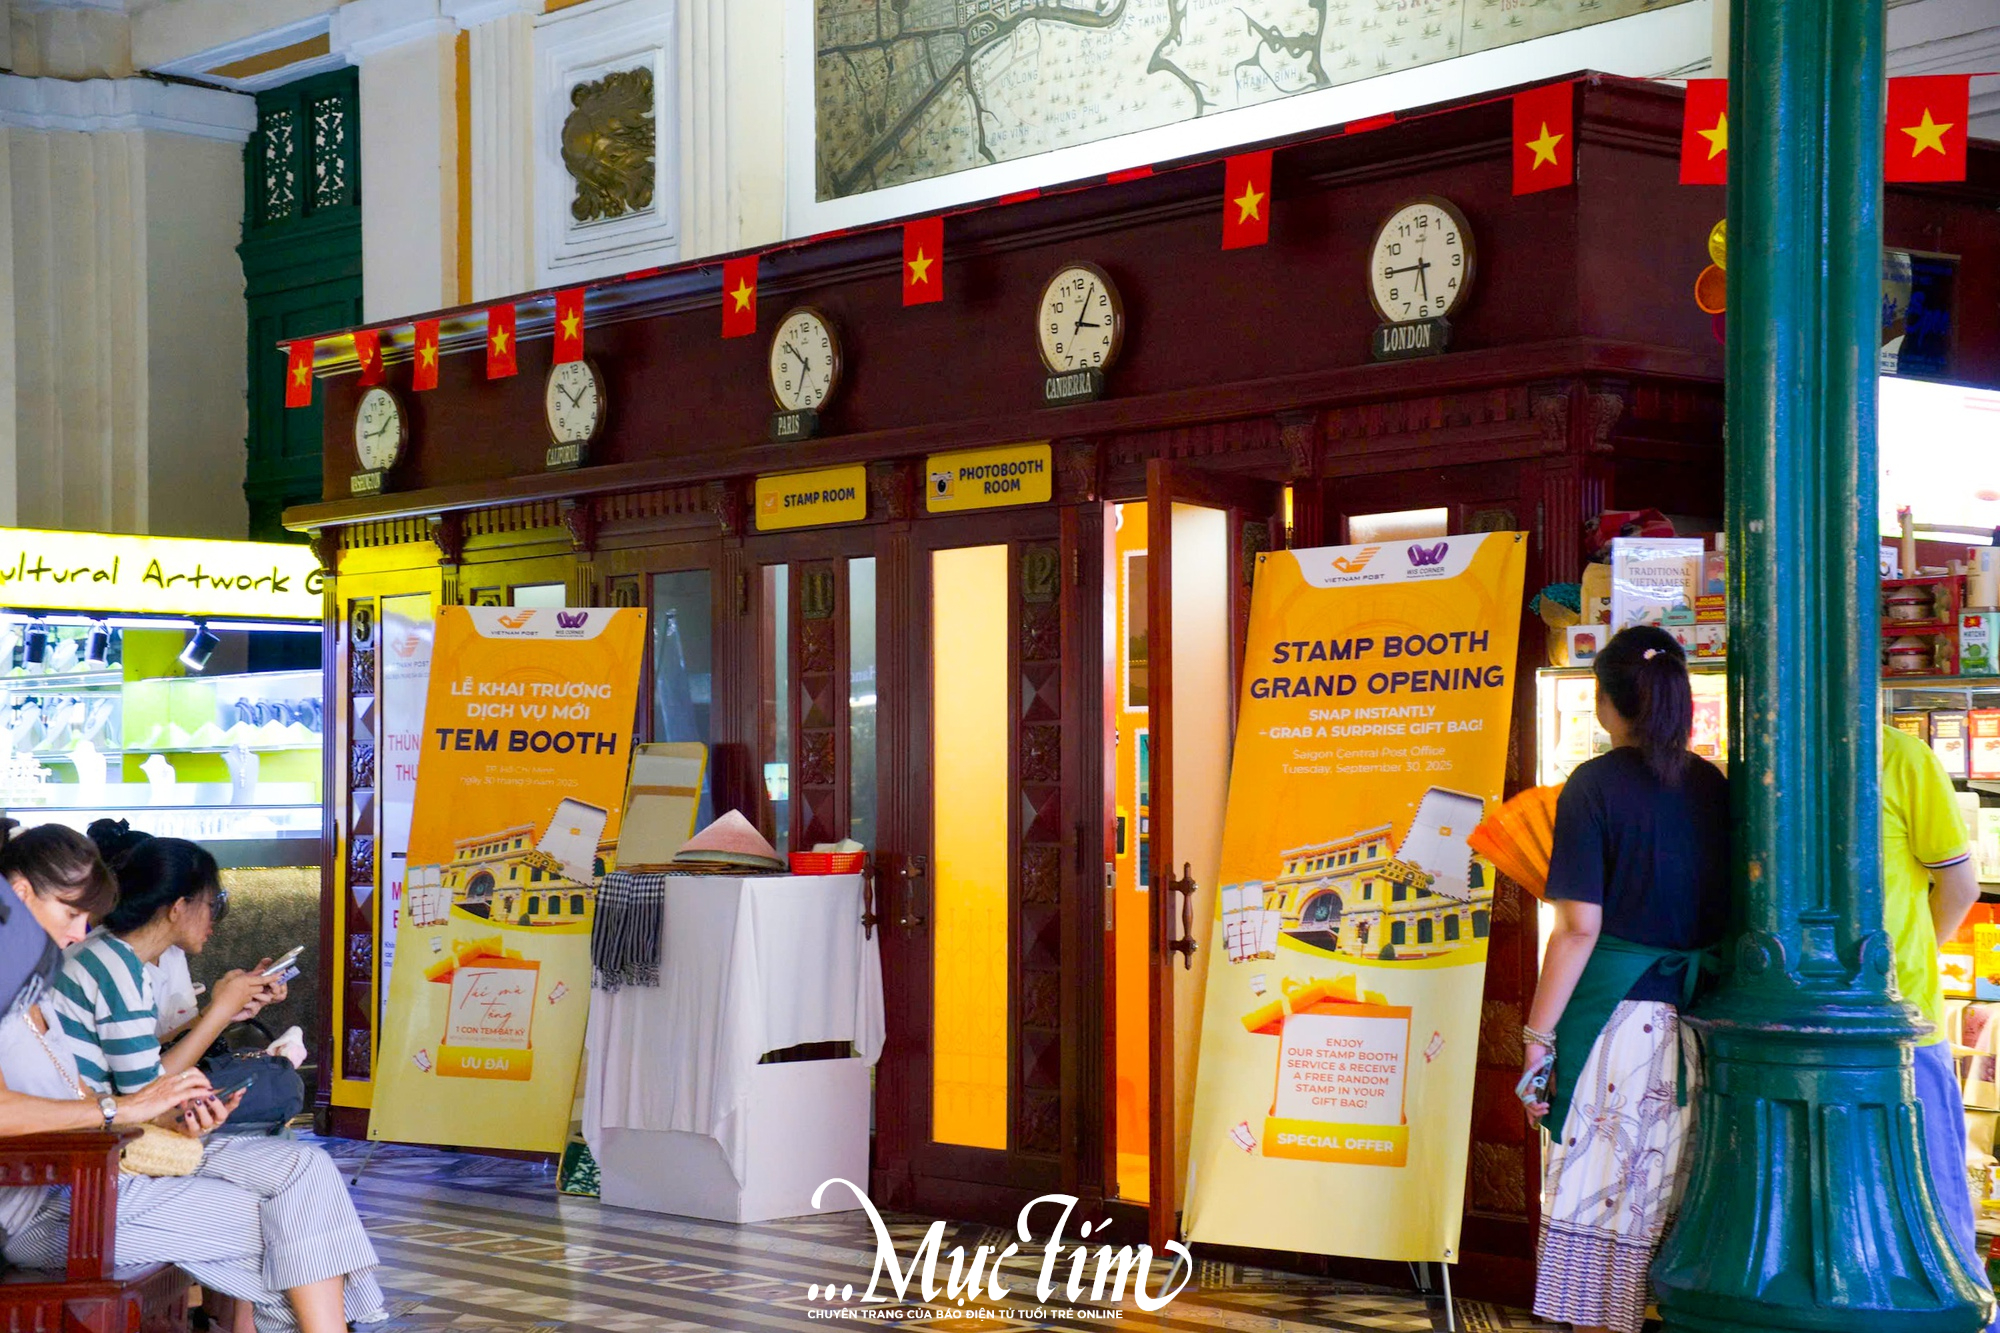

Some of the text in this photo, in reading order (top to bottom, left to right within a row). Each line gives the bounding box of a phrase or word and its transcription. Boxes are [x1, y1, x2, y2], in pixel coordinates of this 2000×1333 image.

[1413, 215, 1428, 228] 12
[1398, 224, 1410, 237] 11
[1446, 232, 1455, 245] 2
[1386, 243, 1401, 256] 10
[1452, 253, 1461, 266] 3
[1072, 278, 1084, 290] 12
[1448, 277, 1457, 289] 4
[1060, 286, 1070, 297] 11
[1390, 288, 1399, 300] 8
[1099, 295, 1107, 306] 2
[1435, 296, 1445, 308] 5
[1051, 302, 1063, 313] 10
[1402, 302, 1411, 314] 7
[1419, 305, 1428, 317] 6
[1104, 315, 1112, 326] 3
[1051, 323, 1058, 334] 9
[1102, 336, 1109, 346] 4
[1383, 324, 1431, 352] LONDON
[1056, 343, 1063, 353] 8
[1065, 355, 1073, 366] 7
[1093, 352, 1100, 362] 5
[1046, 372, 1092, 399] CANBERRA
[777, 414, 800, 436] PARIS
[959, 459, 1044, 495] PHOTOBOOTH ROOM
[783, 487, 855, 508] STAMP ROOM
[143, 558, 290, 593] Artwork
[1324, 574, 1361, 583] VIETNAM
[1628, 567, 1691, 577] TRADITIONAL
[1629, 578, 1691, 587] VIETNAMESE
[1272, 630, 1489, 664] STAMP BOOTH
[1250, 665, 1505, 699] GRAND OPENING
[478, 681, 524, 697] KHAI
[467, 703, 590, 722] DỊCH VỤ MỚI
[1309, 705, 1436, 721] SNAP INSTANTLY
[1269, 718, 1483, 740] GRAB A SURPRISE GIFT BAG!
[435, 728, 617, 755] TEM BOOTH
[1293, 745, 1446, 762] Saigon Central Post Office
[1283, 762, 1333, 775] Tuesday,
[1336, 762, 1402, 775] September
[1426, 760, 1453, 772] 2025
[461, 1026, 479, 1034] CON
[1326, 1038, 1364, 1048] ENJOY
[1287, 1047, 1399, 1062] OUR STAMP BOOTH
[1287, 1059, 1396, 1074] SERVICE & RECEIVE
[1293, 1072, 1389, 1086] A FREE RANDOM
[1295, 1083, 1385, 1098] STAMP IN YOUR
[1311, 1096, 1368, 1109] GIFT BAG!
[1276, 1132, 1394, 1153] SPECIAL OFFER
